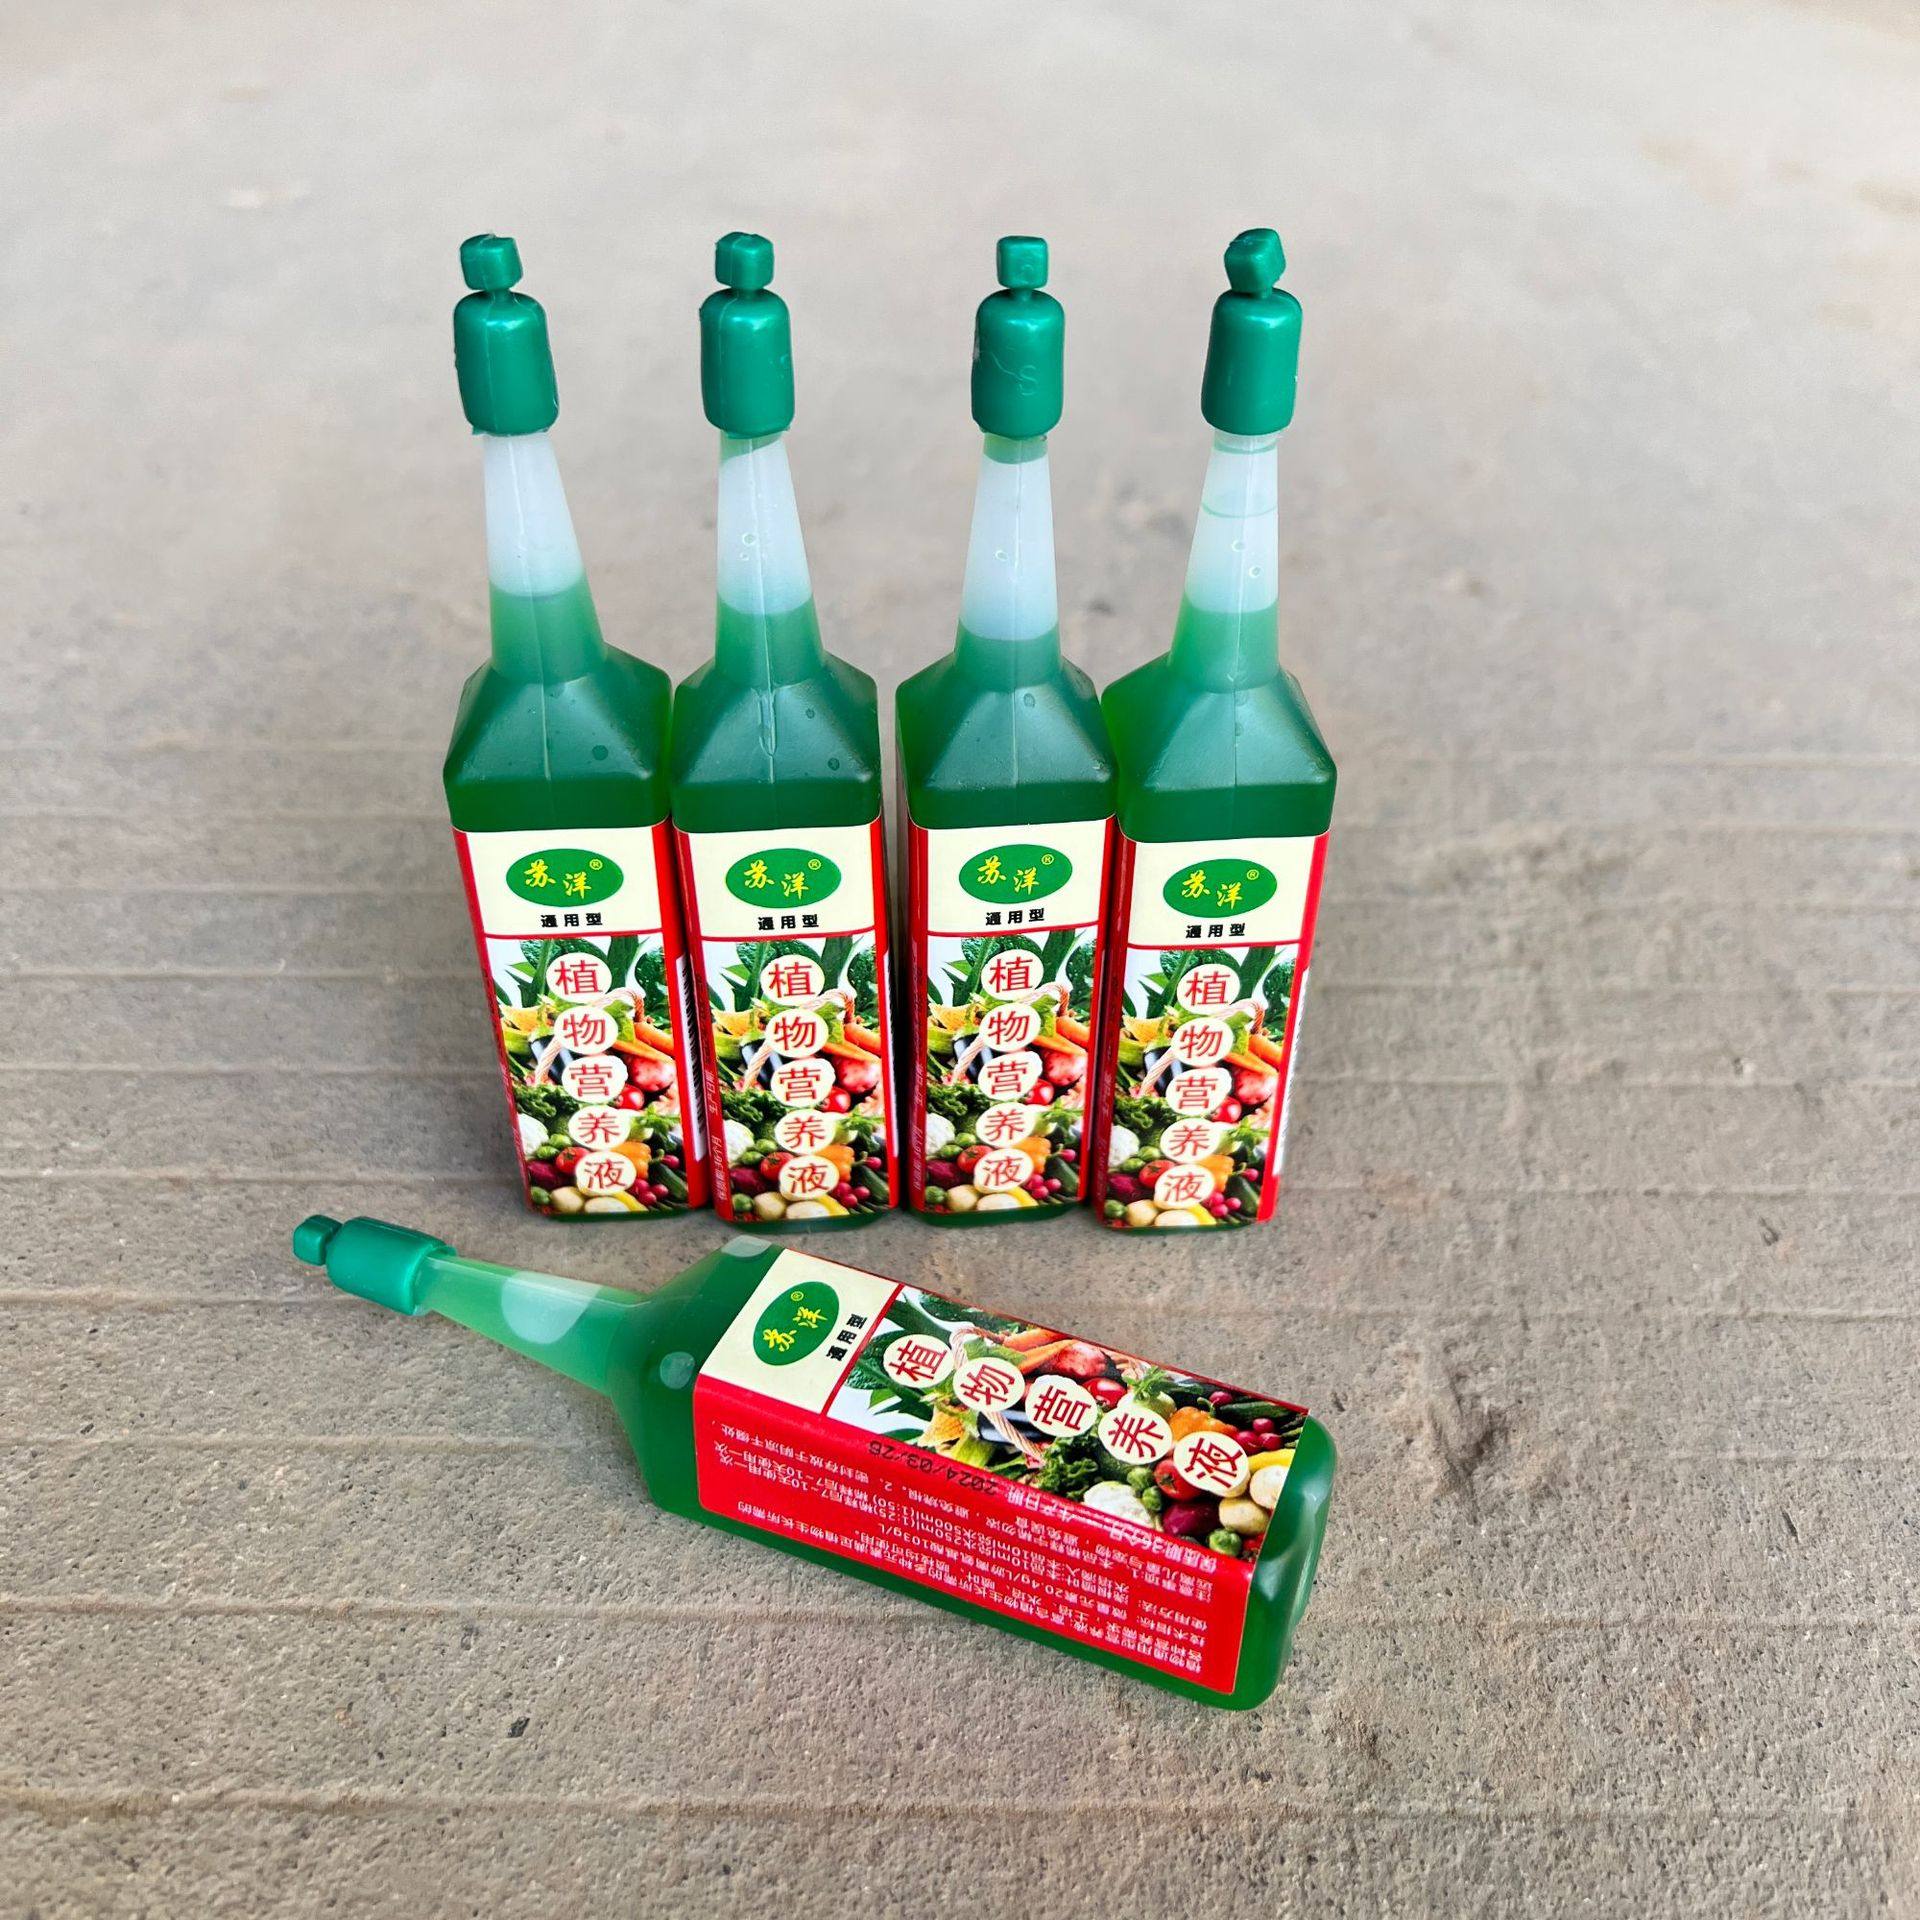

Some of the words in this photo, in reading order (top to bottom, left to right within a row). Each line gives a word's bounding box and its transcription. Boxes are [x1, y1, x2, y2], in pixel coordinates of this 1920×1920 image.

[540, 912, 603, 928] 通用型
[758, 914, 819, 930] 通用型
[985, 908, 1045, 926] 通用型
[1185, 923, 1245, 939] 通用型
[554, 958, 635, 1190] 植物营养液
[767, 962, 827, 1195] 植物营养液
[982, 956, 1033, 1186] 植物营养液
[1164, 971, 1229, 1204] 植物营养液
[826, 1313, 868, 1362] 通用型
